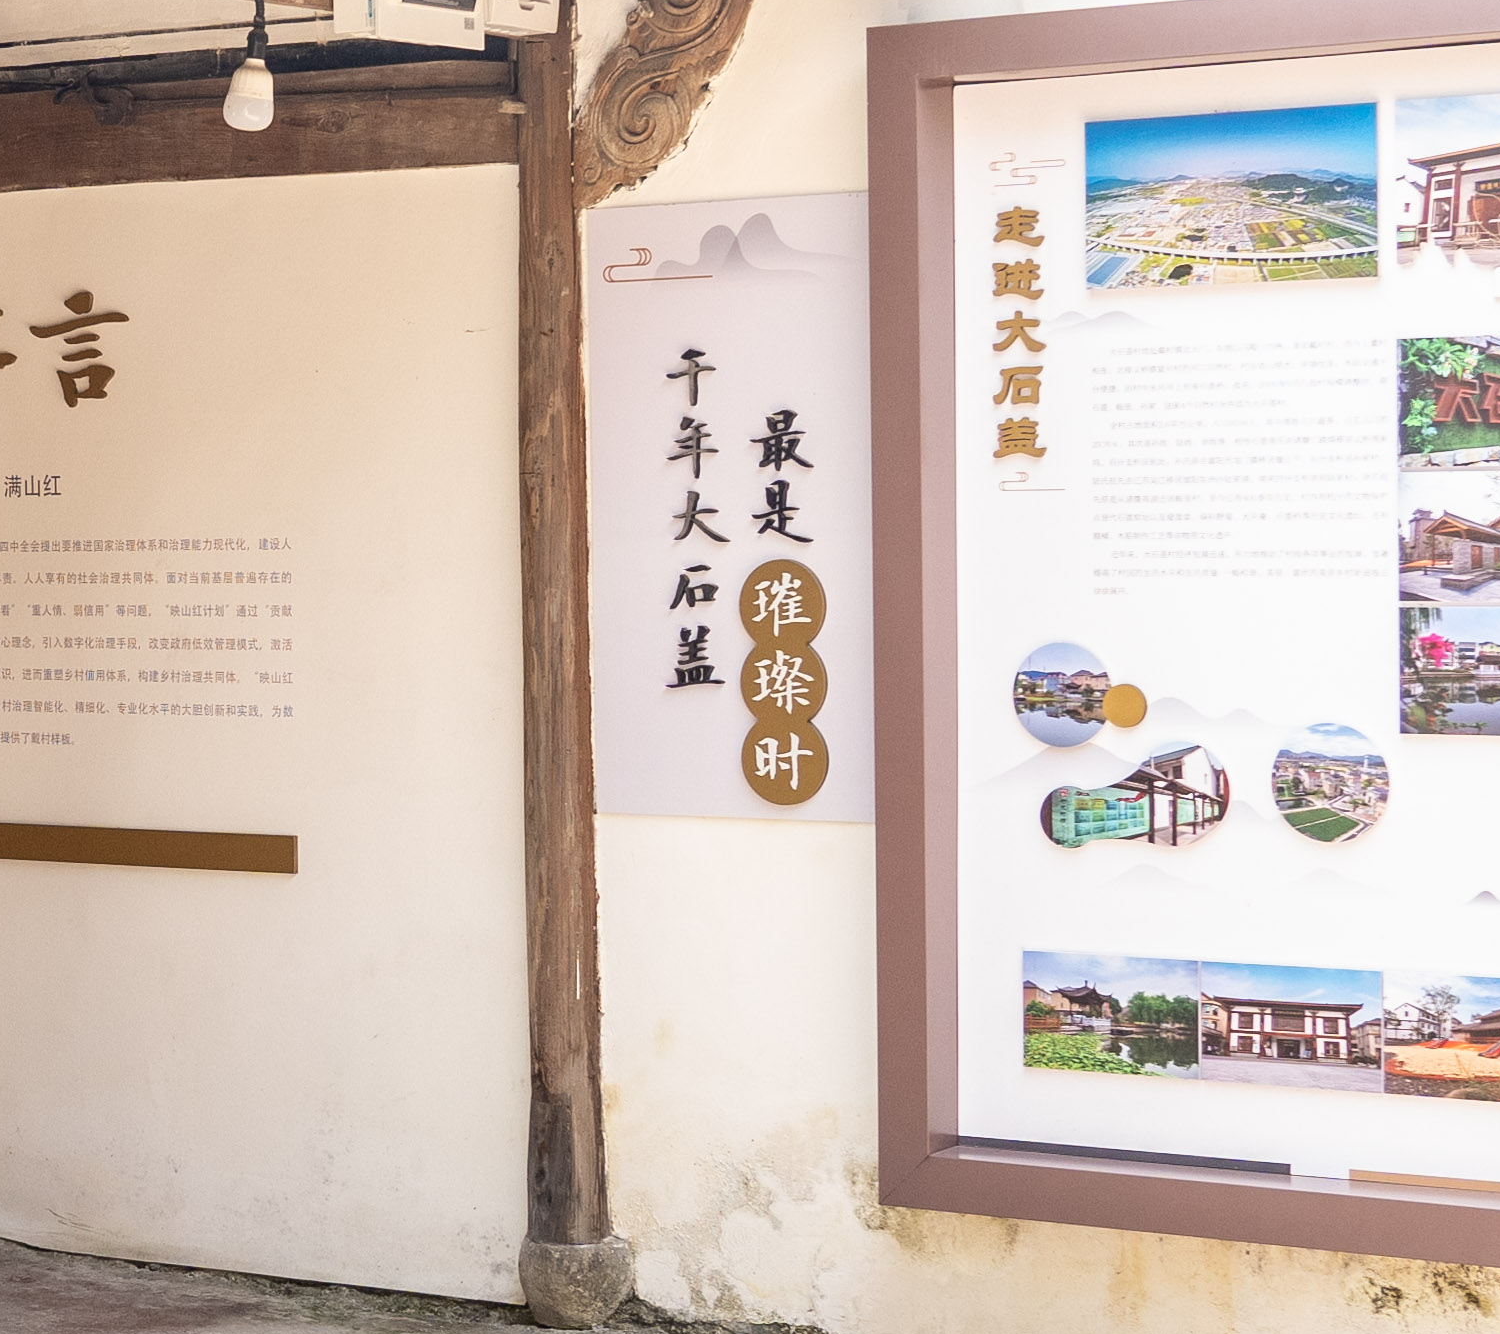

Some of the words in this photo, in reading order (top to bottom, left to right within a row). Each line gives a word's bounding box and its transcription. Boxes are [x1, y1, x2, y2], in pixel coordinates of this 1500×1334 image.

[993, 206, 1047, 460] 走进大石盖
[665, 347, 732, 689] 千年大石盖
[748, 408, 816, 791] 最是璀璨时
